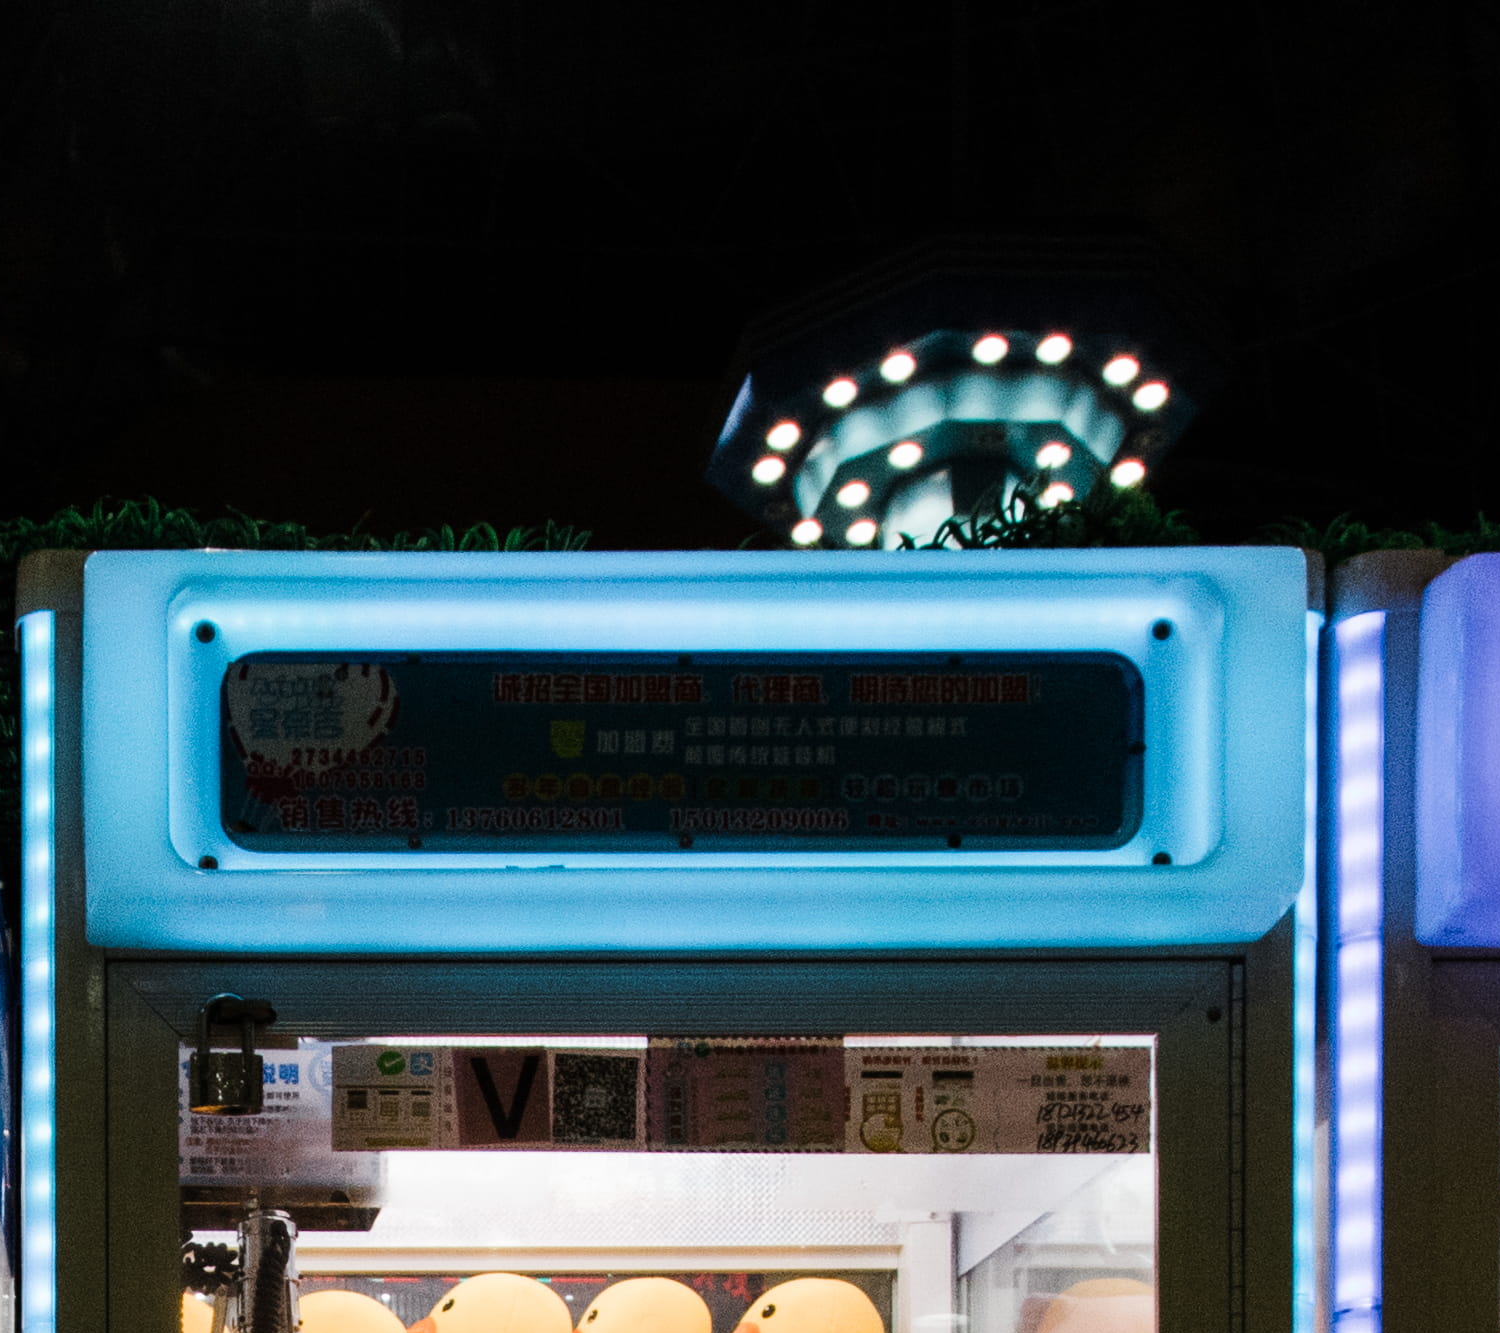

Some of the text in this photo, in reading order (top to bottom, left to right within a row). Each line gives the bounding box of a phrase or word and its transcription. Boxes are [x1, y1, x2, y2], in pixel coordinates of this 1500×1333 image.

[291, 748, 426, 766] 2734462715
[291, 771, 426, 789] 1607958168
[278, 798, 433, 829] 销售热线:
[446, 807, 624, 830] 13760612801
[670, 807, 849, 831] 15013209006
[470, 1056, 539, 1138] V
